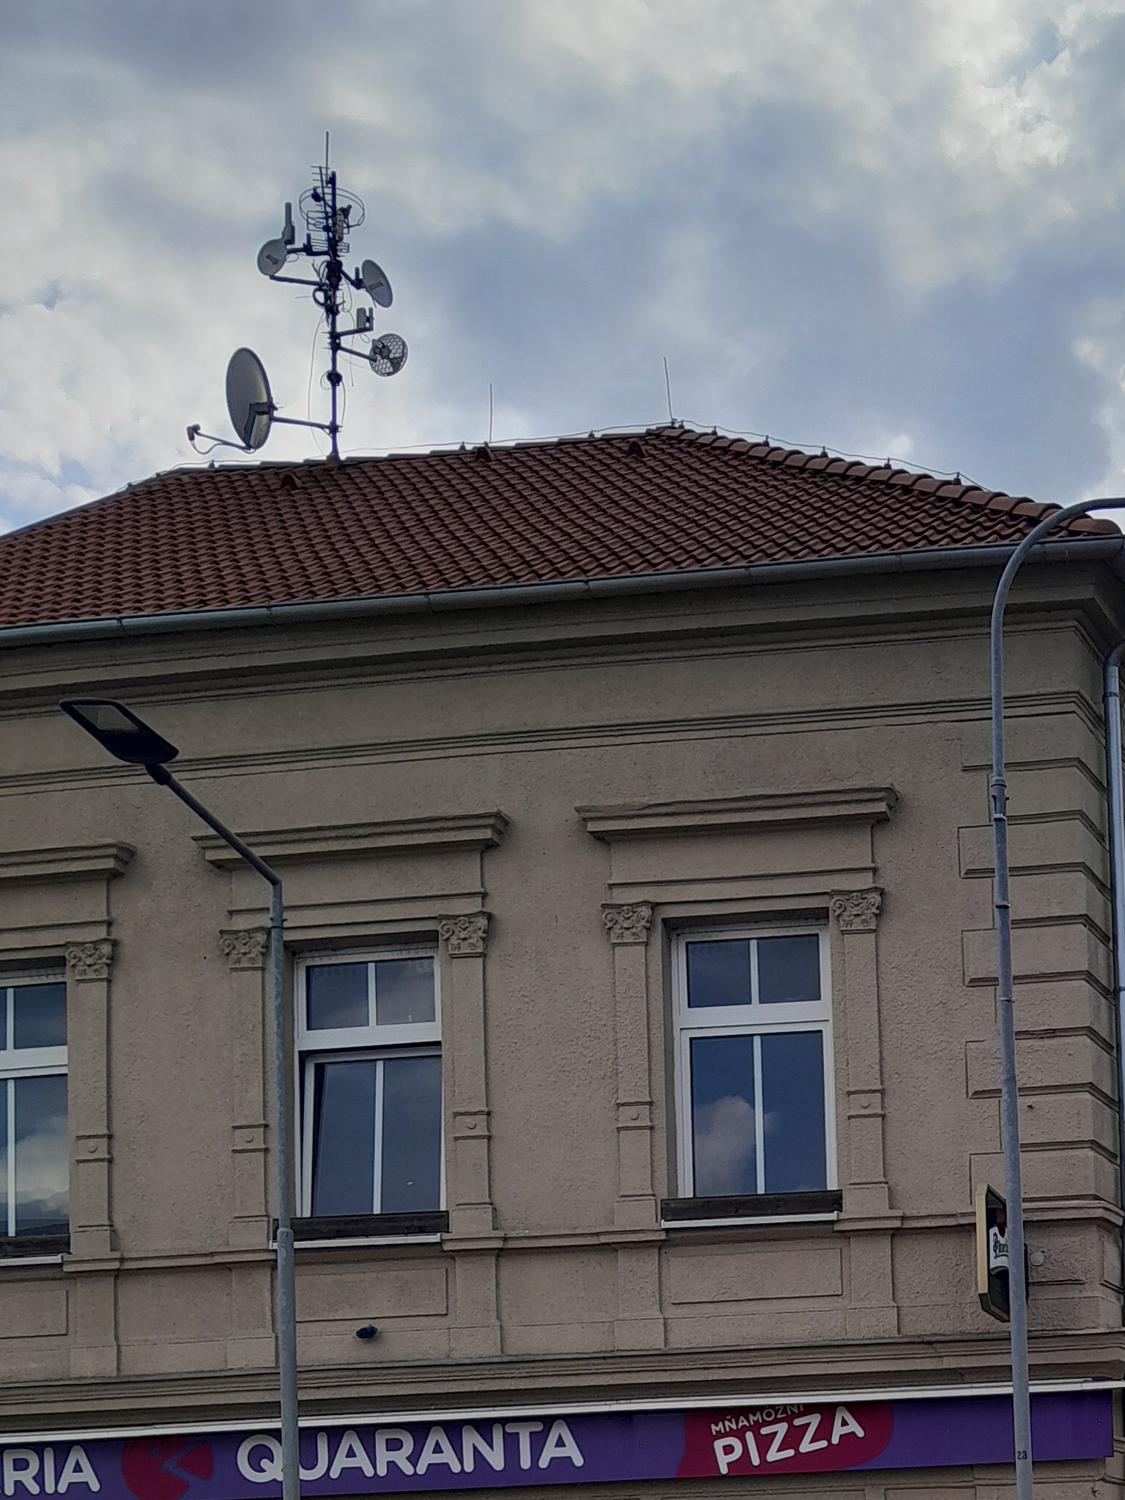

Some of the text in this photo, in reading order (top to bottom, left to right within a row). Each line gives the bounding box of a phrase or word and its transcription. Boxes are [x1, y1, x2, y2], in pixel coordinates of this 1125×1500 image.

[0, 1419, 584, 1496] RIA QUARANTA
[713, 1406, 865, 1475] PIZZA
